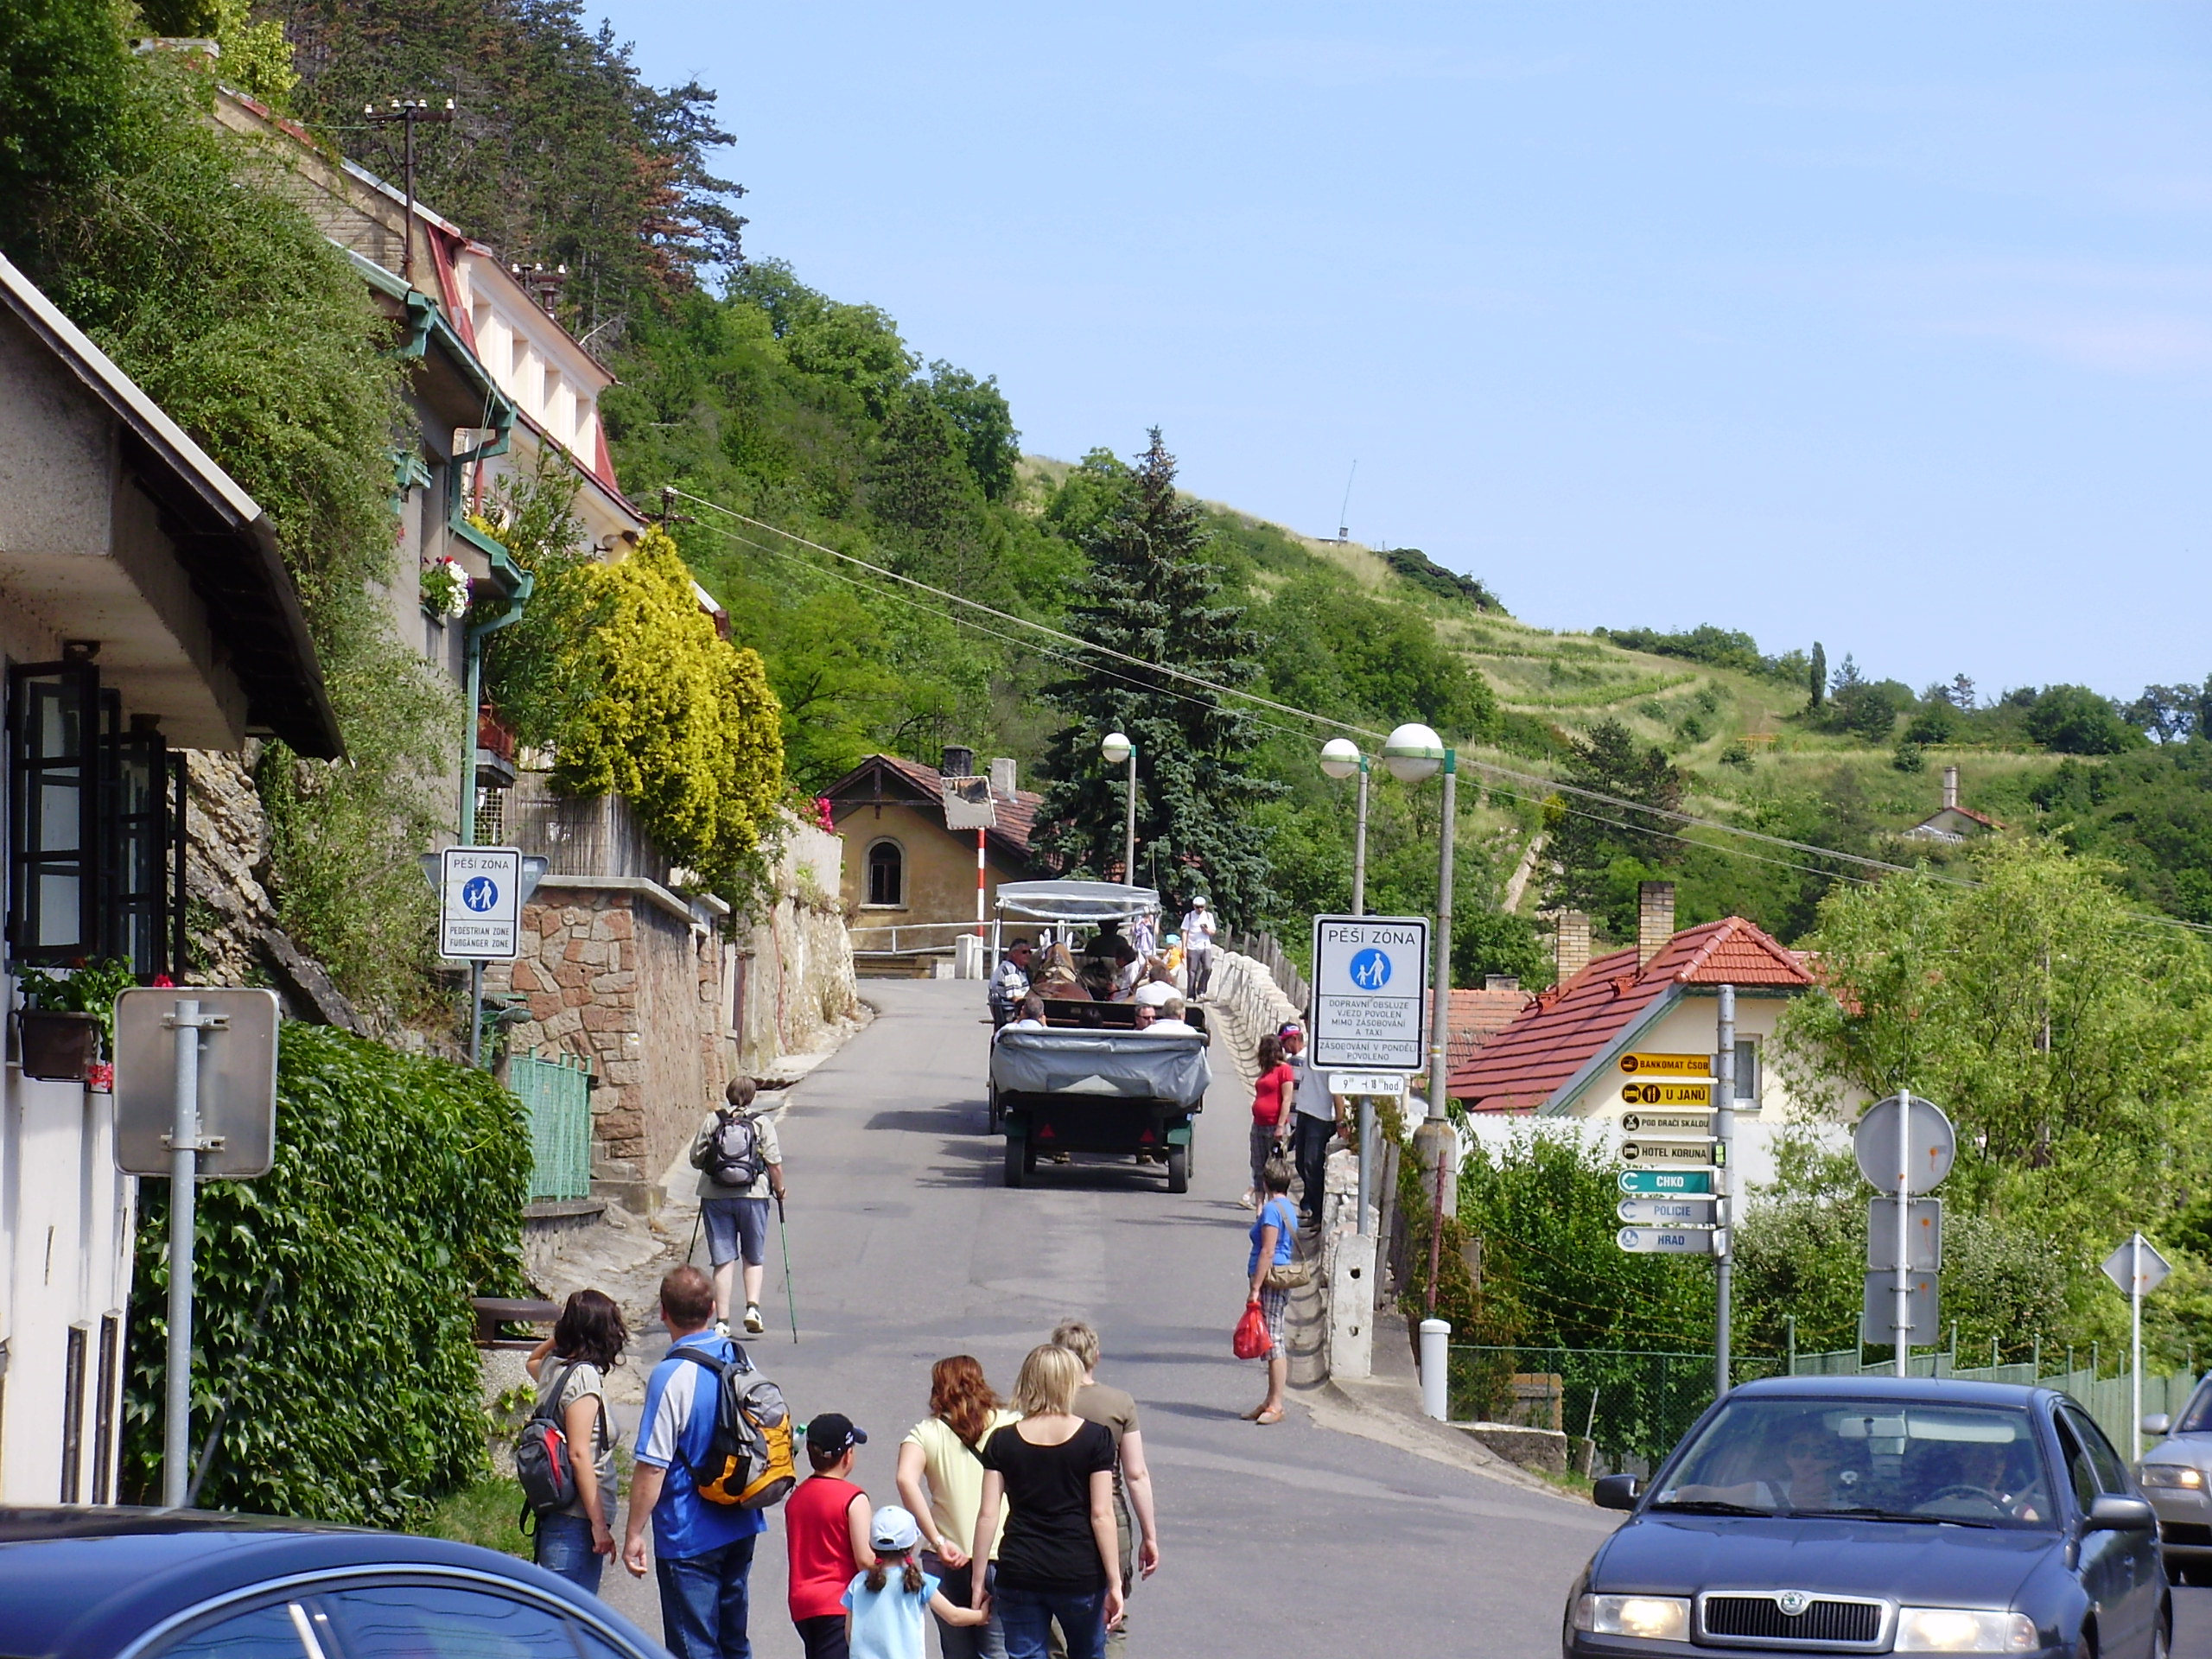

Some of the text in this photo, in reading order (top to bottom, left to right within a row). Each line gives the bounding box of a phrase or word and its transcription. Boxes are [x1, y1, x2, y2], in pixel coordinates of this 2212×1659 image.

[454, 857, 509, 869] PĚŠÍ ZÓNA
[449, 926, 510, 936] PEDESTRIAN ZONE
[1329, 927, 1415, 944] PĚŠÍ ZÓNA
[492, 939, 509, 948] ZONE
[1329, 1000, 1370, 1008] DOPRAVNÍ
[1356, 1019, 1406, 1027] ZÁSOBOVÁNÍ
[1319, 1041, 1370, 1051] ZÁSOBOVÁNÍ
[1382, 1043, 1417, 1052] PONDĚLÍ
[1640, 1059, 1708, 1070] BANKOMAT ČSOB
[1666, 1086, 1706, 1101] U JANŮ
[1642, 1147, 1707, 1158] HOTEL KORUNA
[1656, 1175, 1685, 1187] CHKO
[1654, 1205, 1691, 1217] POLICIE
[1657, 1235, 1685, 1245] HRAD
